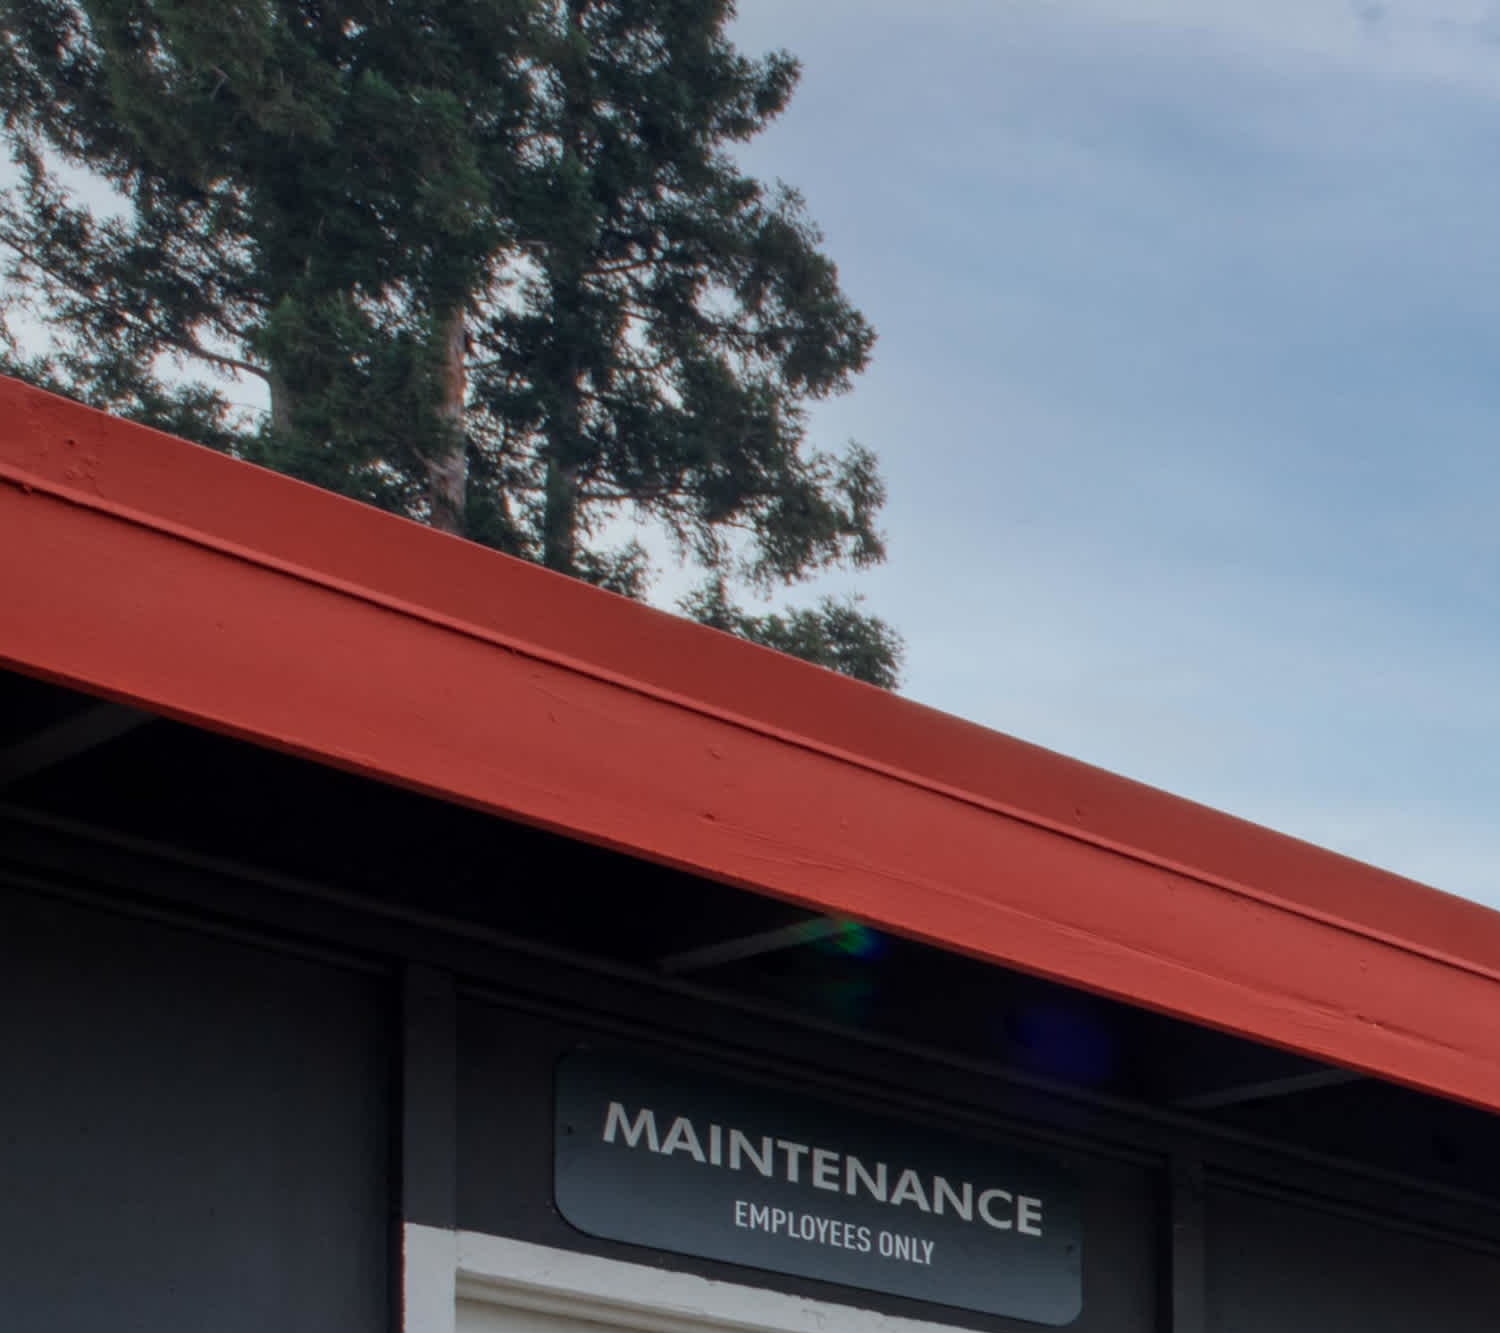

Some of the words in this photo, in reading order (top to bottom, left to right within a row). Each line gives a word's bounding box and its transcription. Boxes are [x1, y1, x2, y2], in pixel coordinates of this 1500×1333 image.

[602, 1101, 1043, 1236] MAINTENANCE
[734, 1200, 871, 1252] EMPLOYEES
[878, 1231, 935, 1265] ONLY
